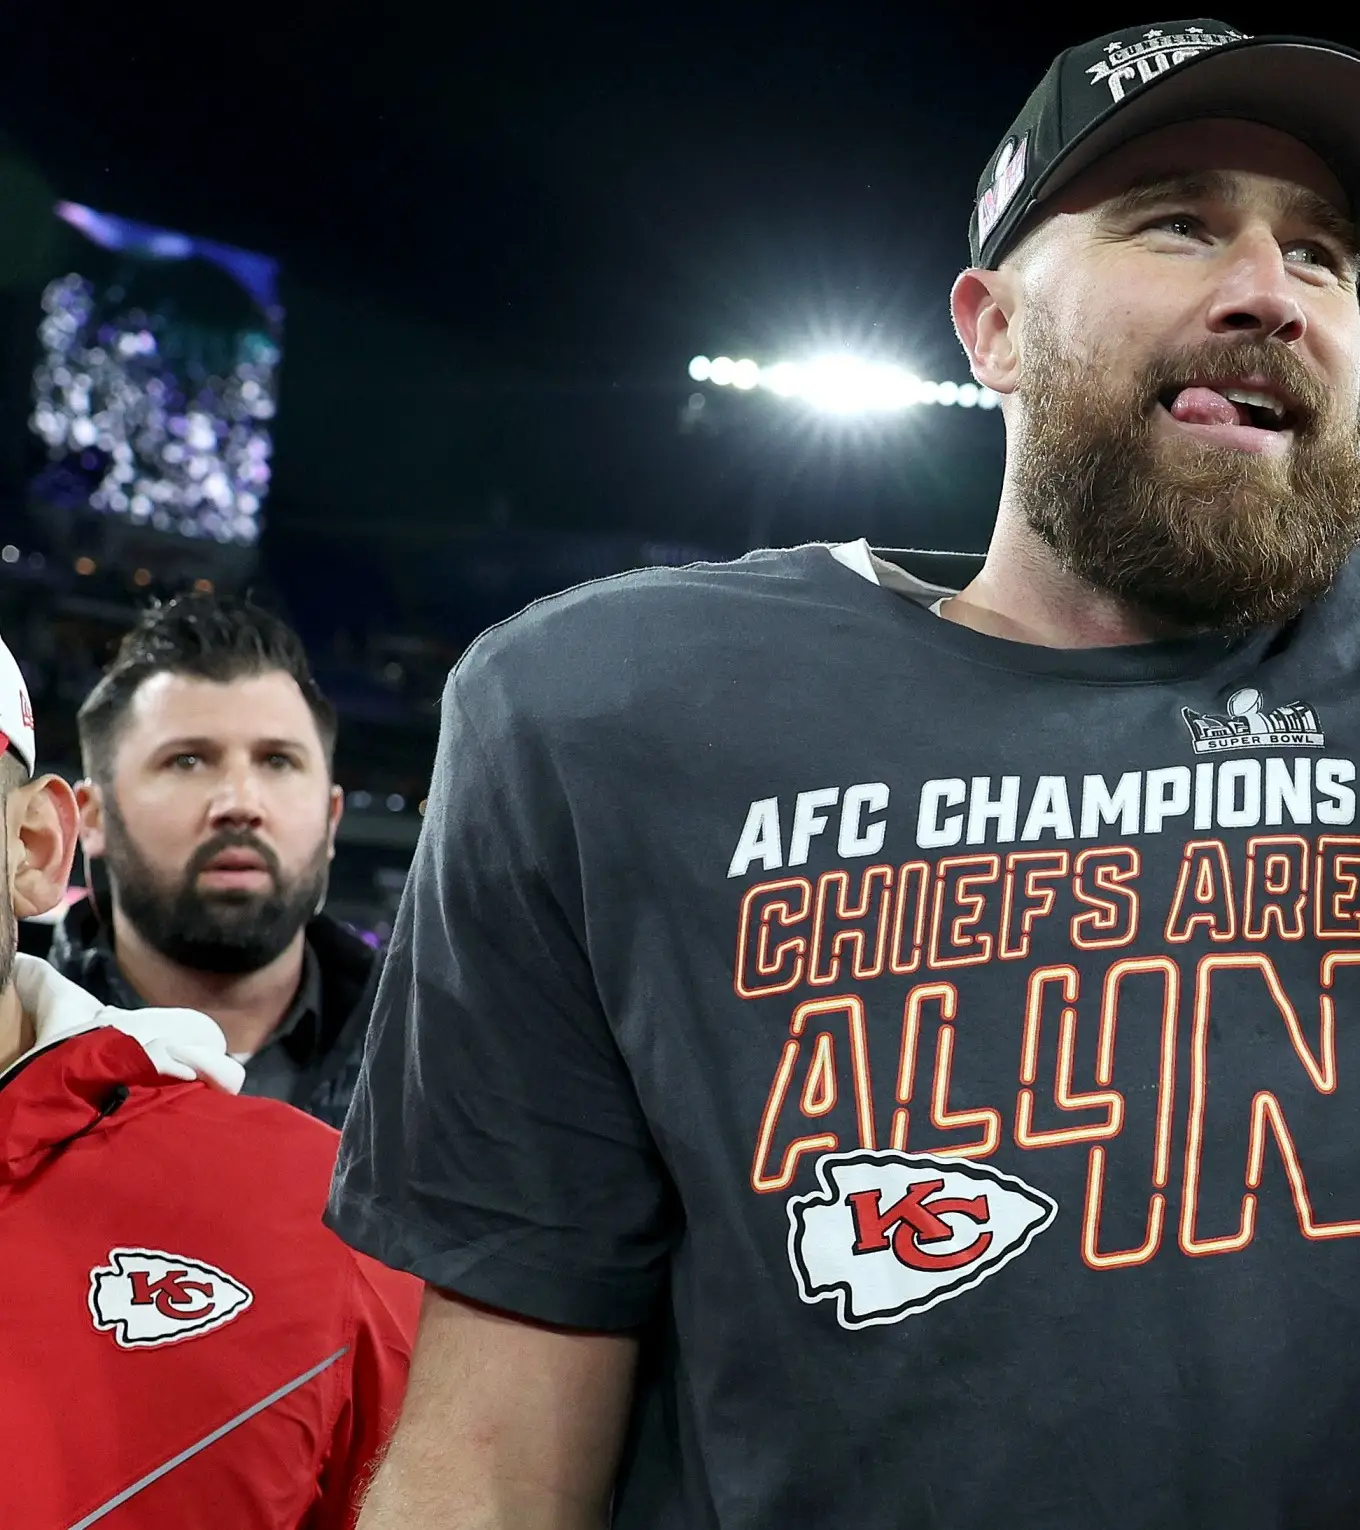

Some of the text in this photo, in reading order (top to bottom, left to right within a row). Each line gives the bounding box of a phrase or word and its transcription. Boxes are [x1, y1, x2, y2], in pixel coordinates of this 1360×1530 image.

[1208, 734, 1314, 748] SUPER BOWL
[727, 757, 1357, 879] AFC CHAMPIONS
[736, 846, 1141, 999] CHIEFS
[845, 1178, 993, 1272] KC
[127, 1270, 215, 1320] KC
